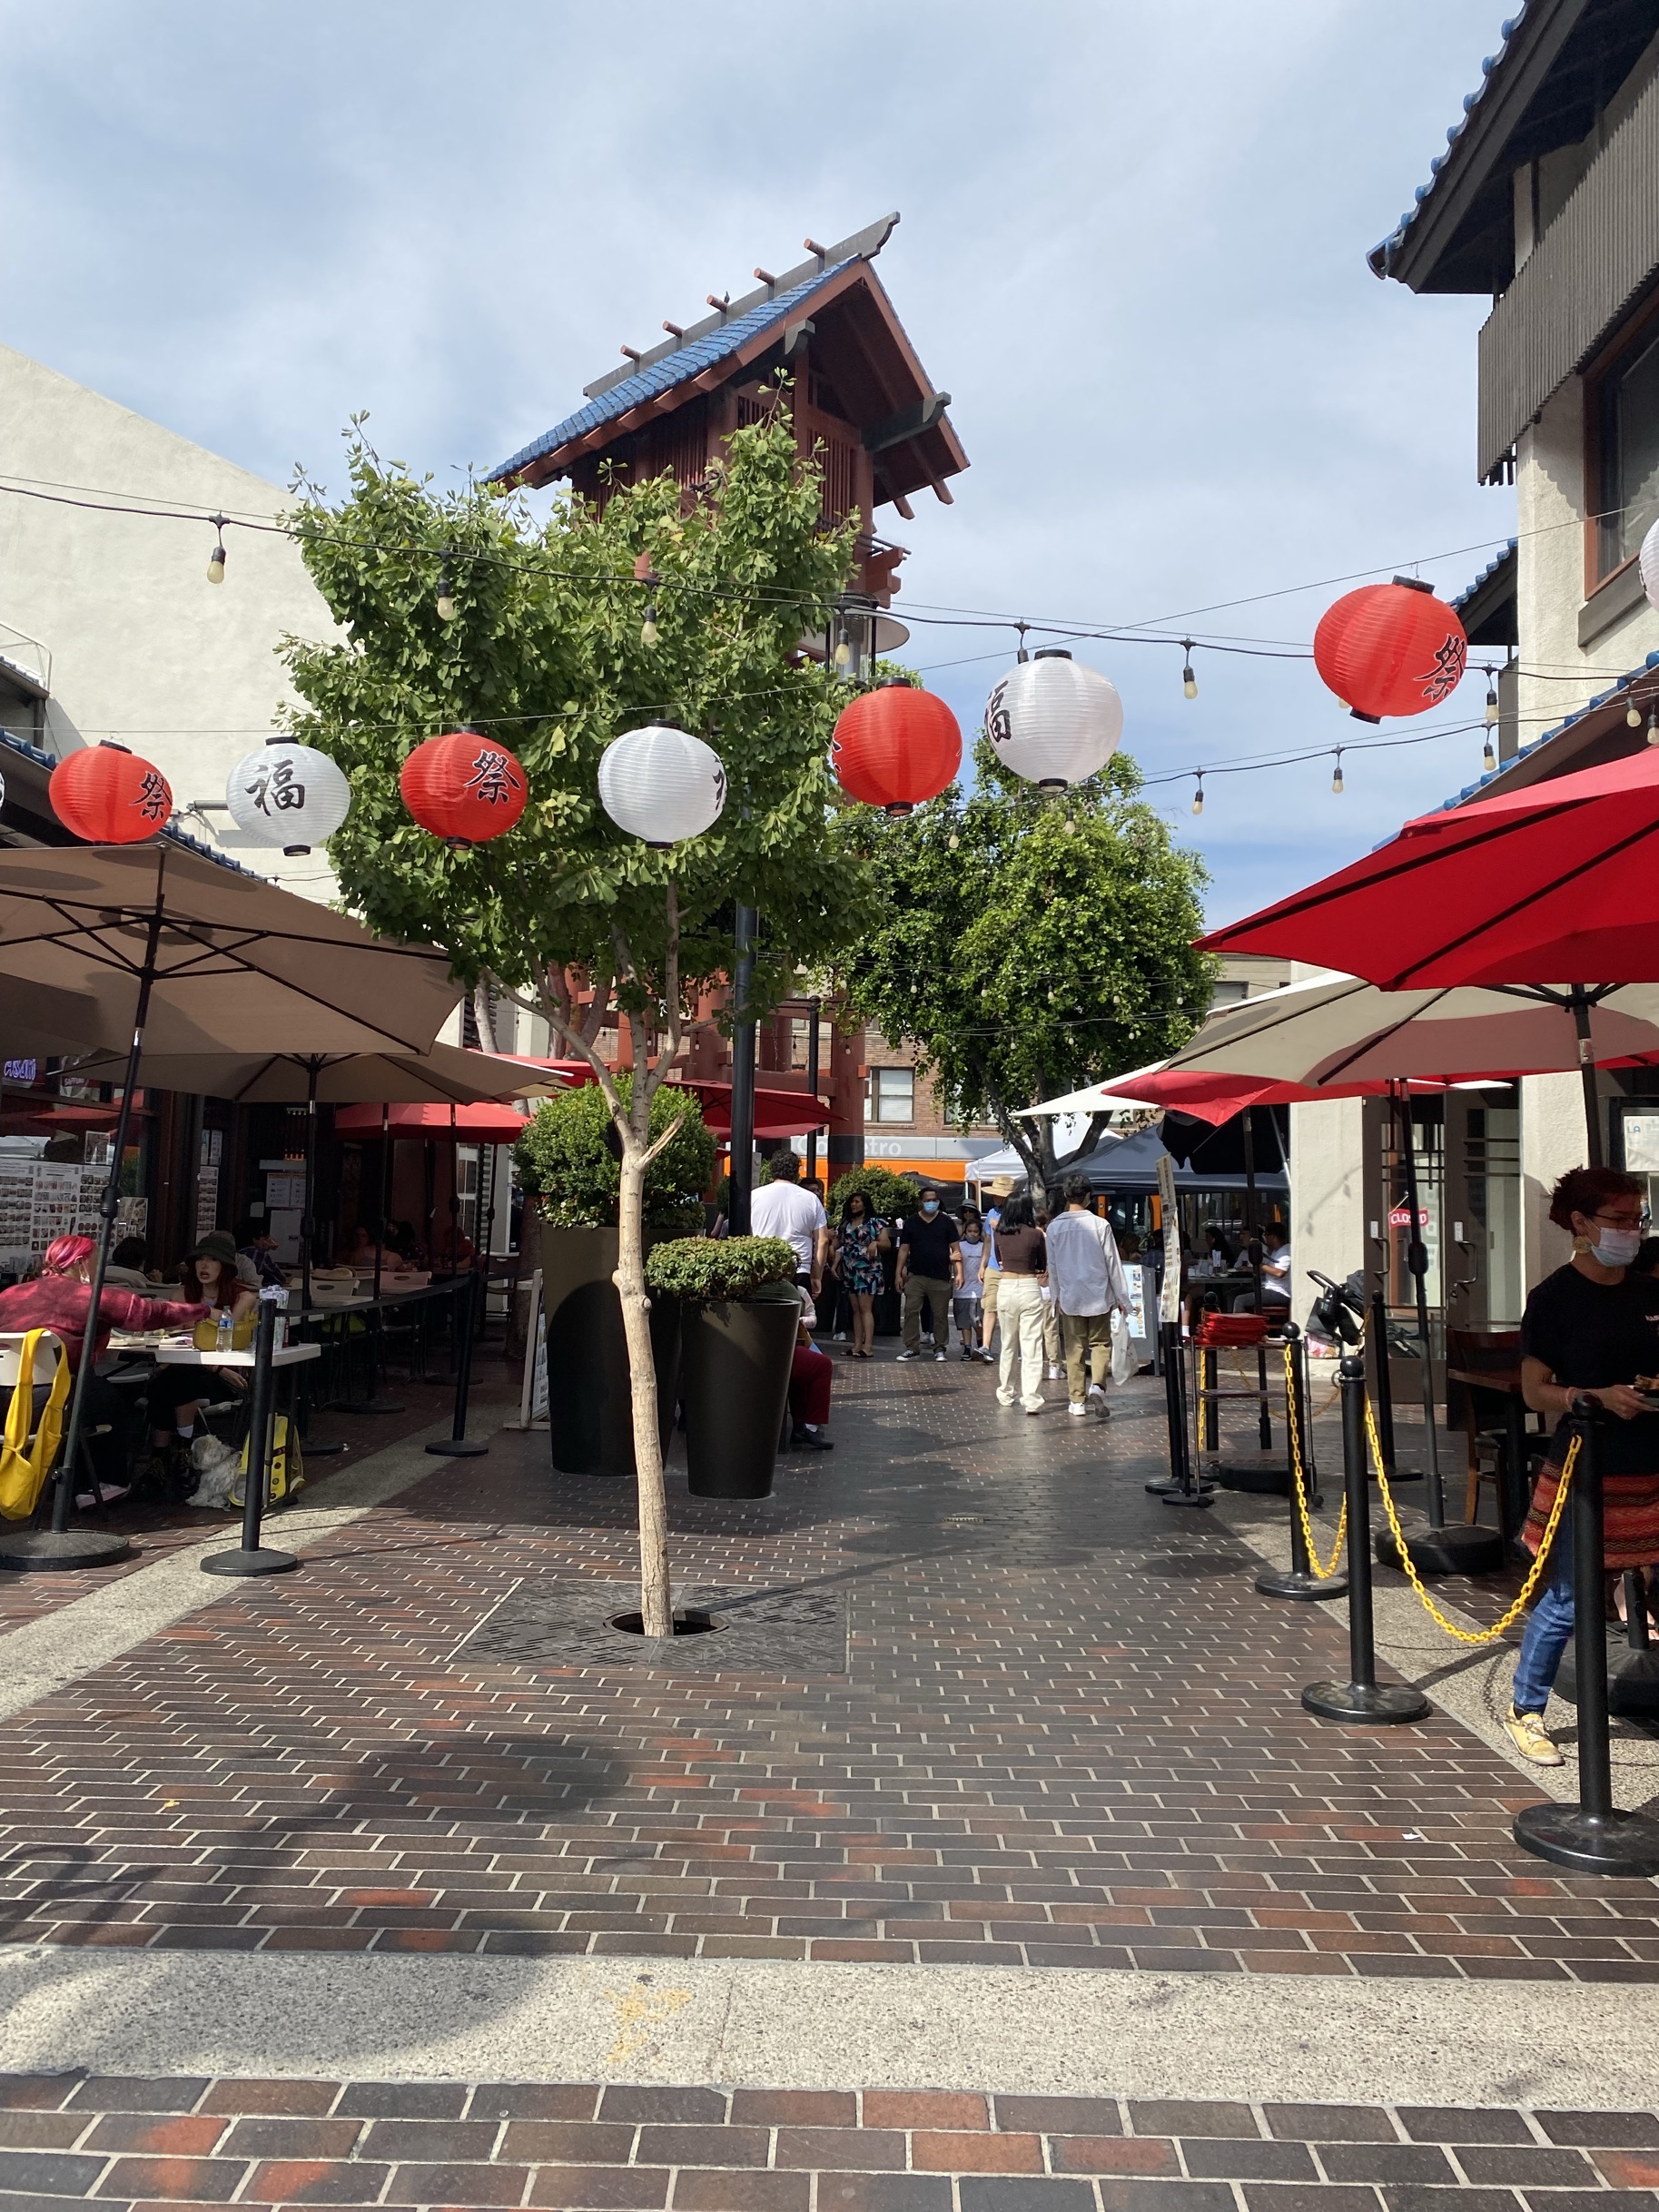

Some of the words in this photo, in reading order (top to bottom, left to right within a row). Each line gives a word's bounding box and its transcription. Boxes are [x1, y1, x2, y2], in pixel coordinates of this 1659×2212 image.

[1413, 633, 1465, 702] 祭
[128, 770, 173, 822] 祭
[244, 758, 305, 817] 福
[462, 749, 521, 806] 祭
[1390, 1212, 1427, 1225] CLOD
